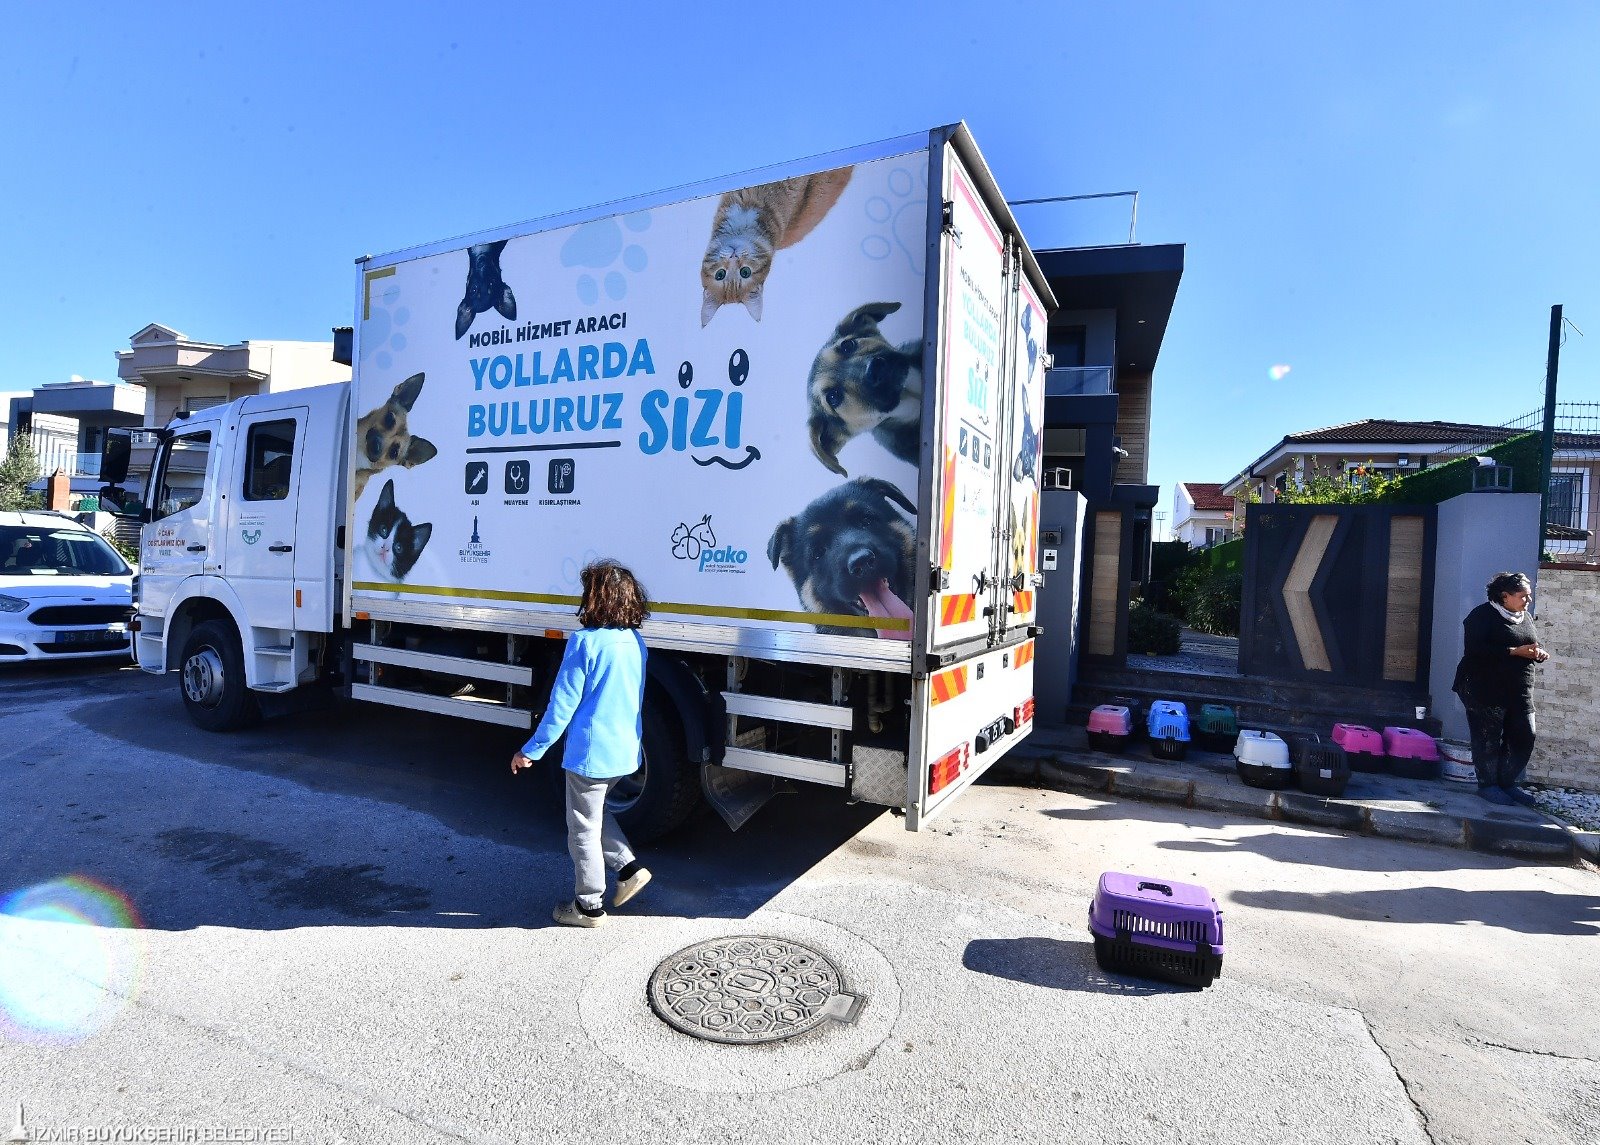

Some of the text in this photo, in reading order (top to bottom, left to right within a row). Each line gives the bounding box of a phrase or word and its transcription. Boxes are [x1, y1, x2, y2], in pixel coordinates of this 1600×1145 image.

[469, 312, 628, 349] MOBİL HİZMET ARACI
[469, 338, 656, 391] YOLLARDA
[468, 392, 624, 437] BULURUZ
[638, 348, 749, 455] SİZİ
[698, 545, 748, 572] pako
